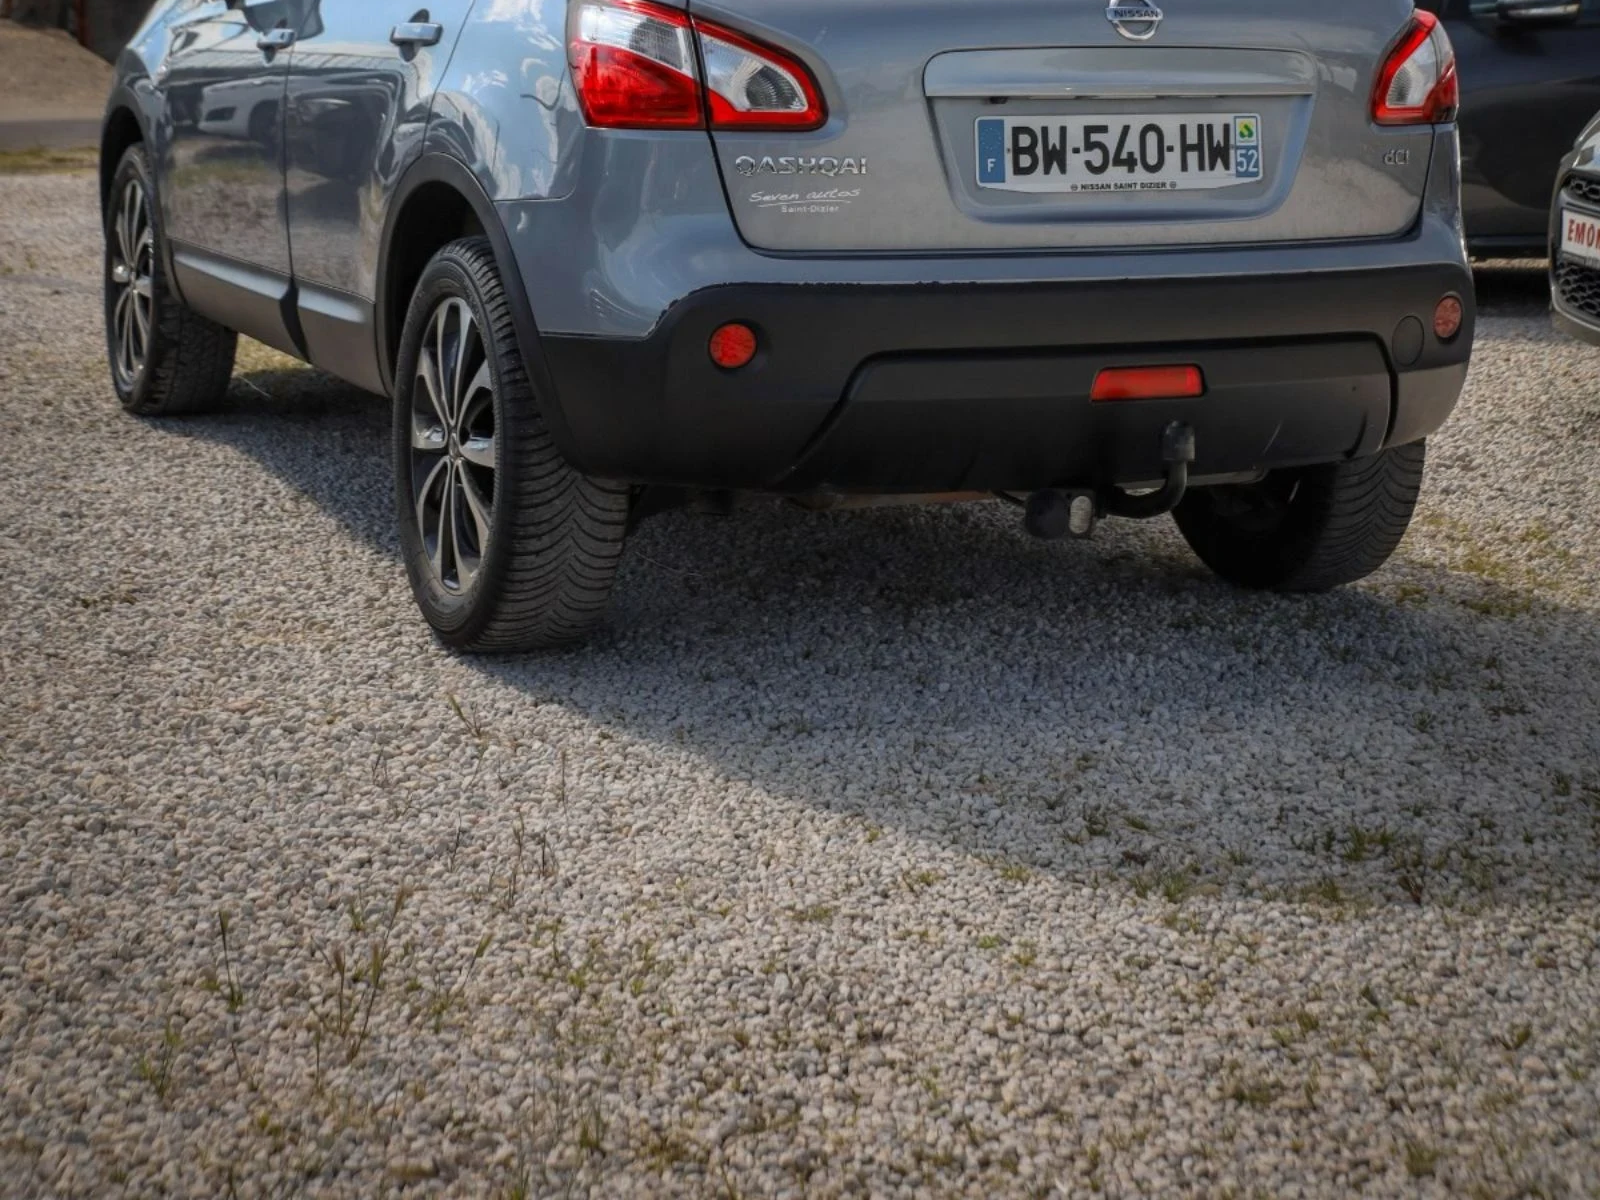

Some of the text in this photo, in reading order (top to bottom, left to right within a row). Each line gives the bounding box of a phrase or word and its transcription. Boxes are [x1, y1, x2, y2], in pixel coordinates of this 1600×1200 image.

[1113, 9, 1159, 18] NISSAN
[1010, 123, 1231, 176] BW-540-HW
[735, 155, 868, 177] QASHQAI
[986, 158, 996, 173] F
[1236, 148, 1258, 172] 52
[1080, 181, 1168, 191] NISSAN SAINT DIZIER
[781, 205, 839, 213] Saint-Dizier
